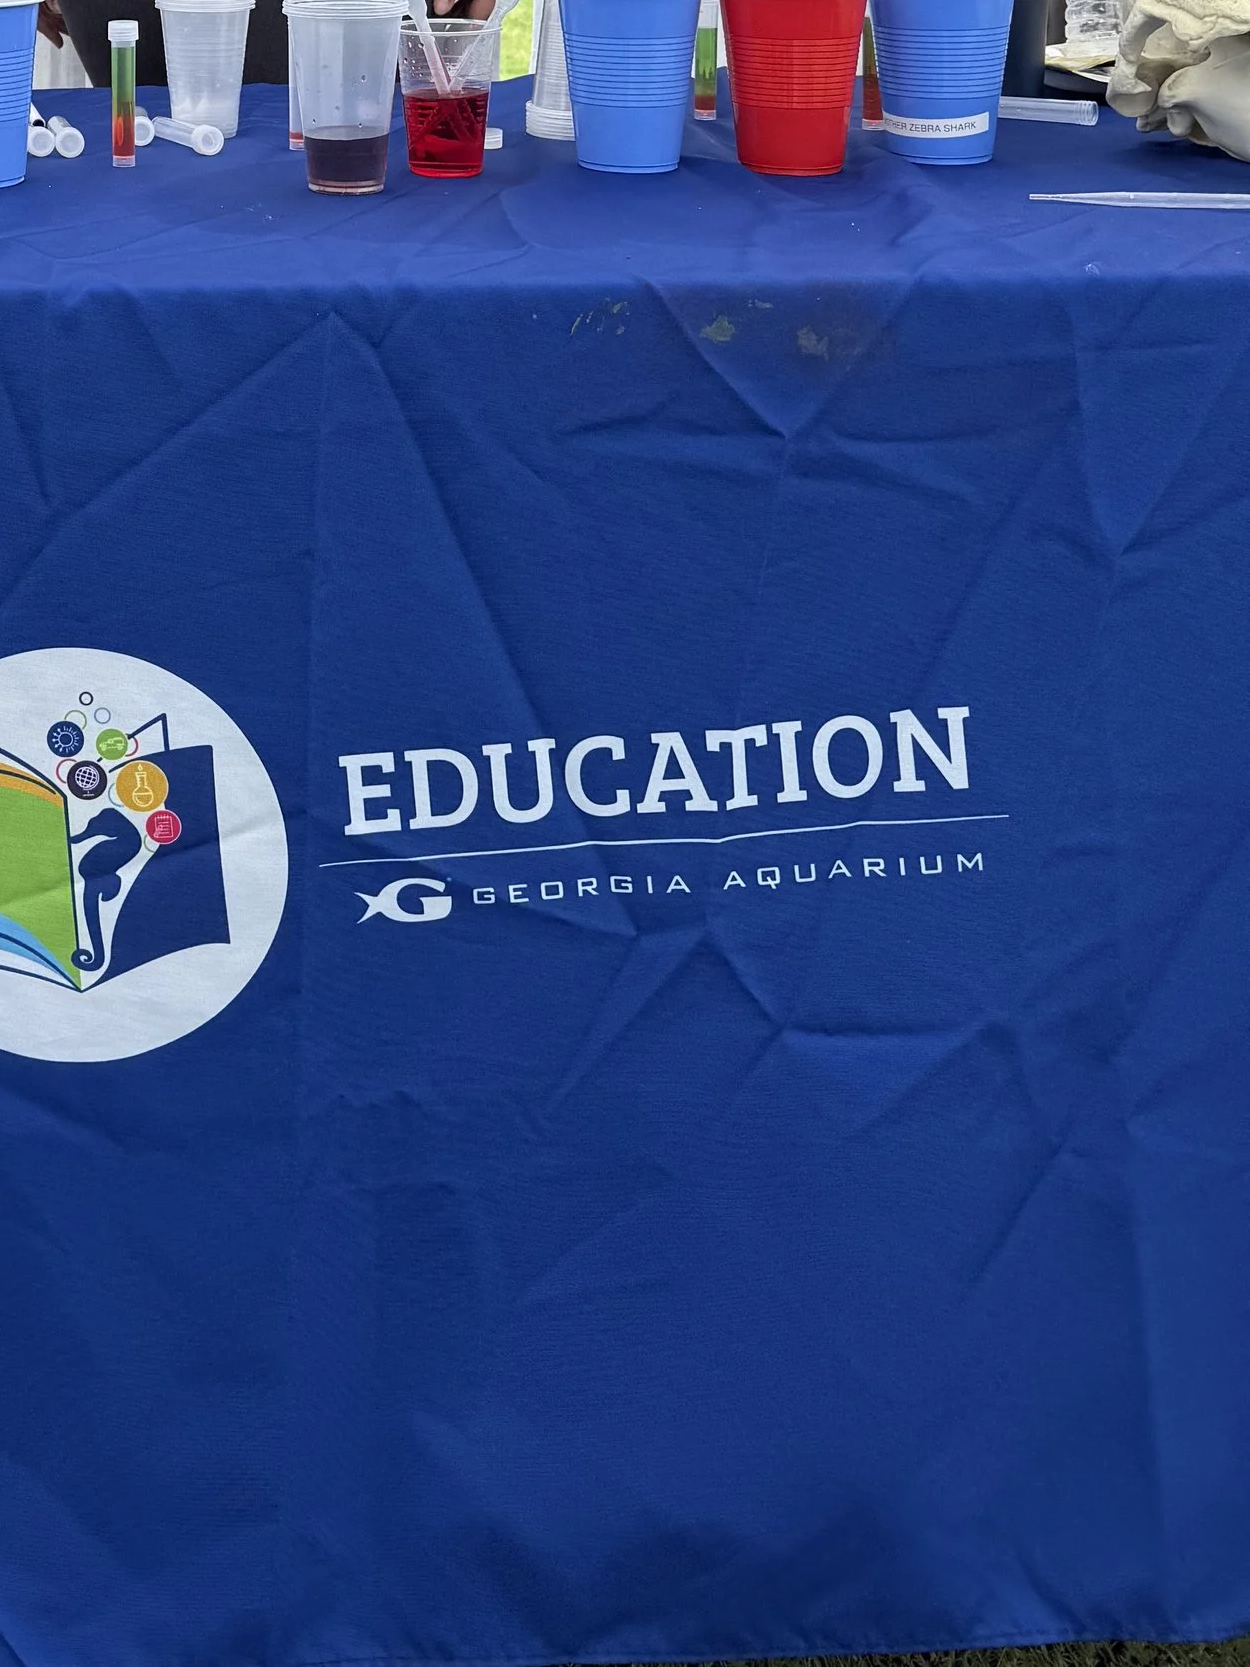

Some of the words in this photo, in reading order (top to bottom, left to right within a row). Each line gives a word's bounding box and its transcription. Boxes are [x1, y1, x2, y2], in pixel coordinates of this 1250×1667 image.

[909, 123, 941, 133] ZEBRA
[943, 121, 976, 133] SHARK
[338, 706, 970, 836] EDUCATION
[472, 875, 691, 905] GEORGIA
[723, 852, 984, 890] AQUARIUM
